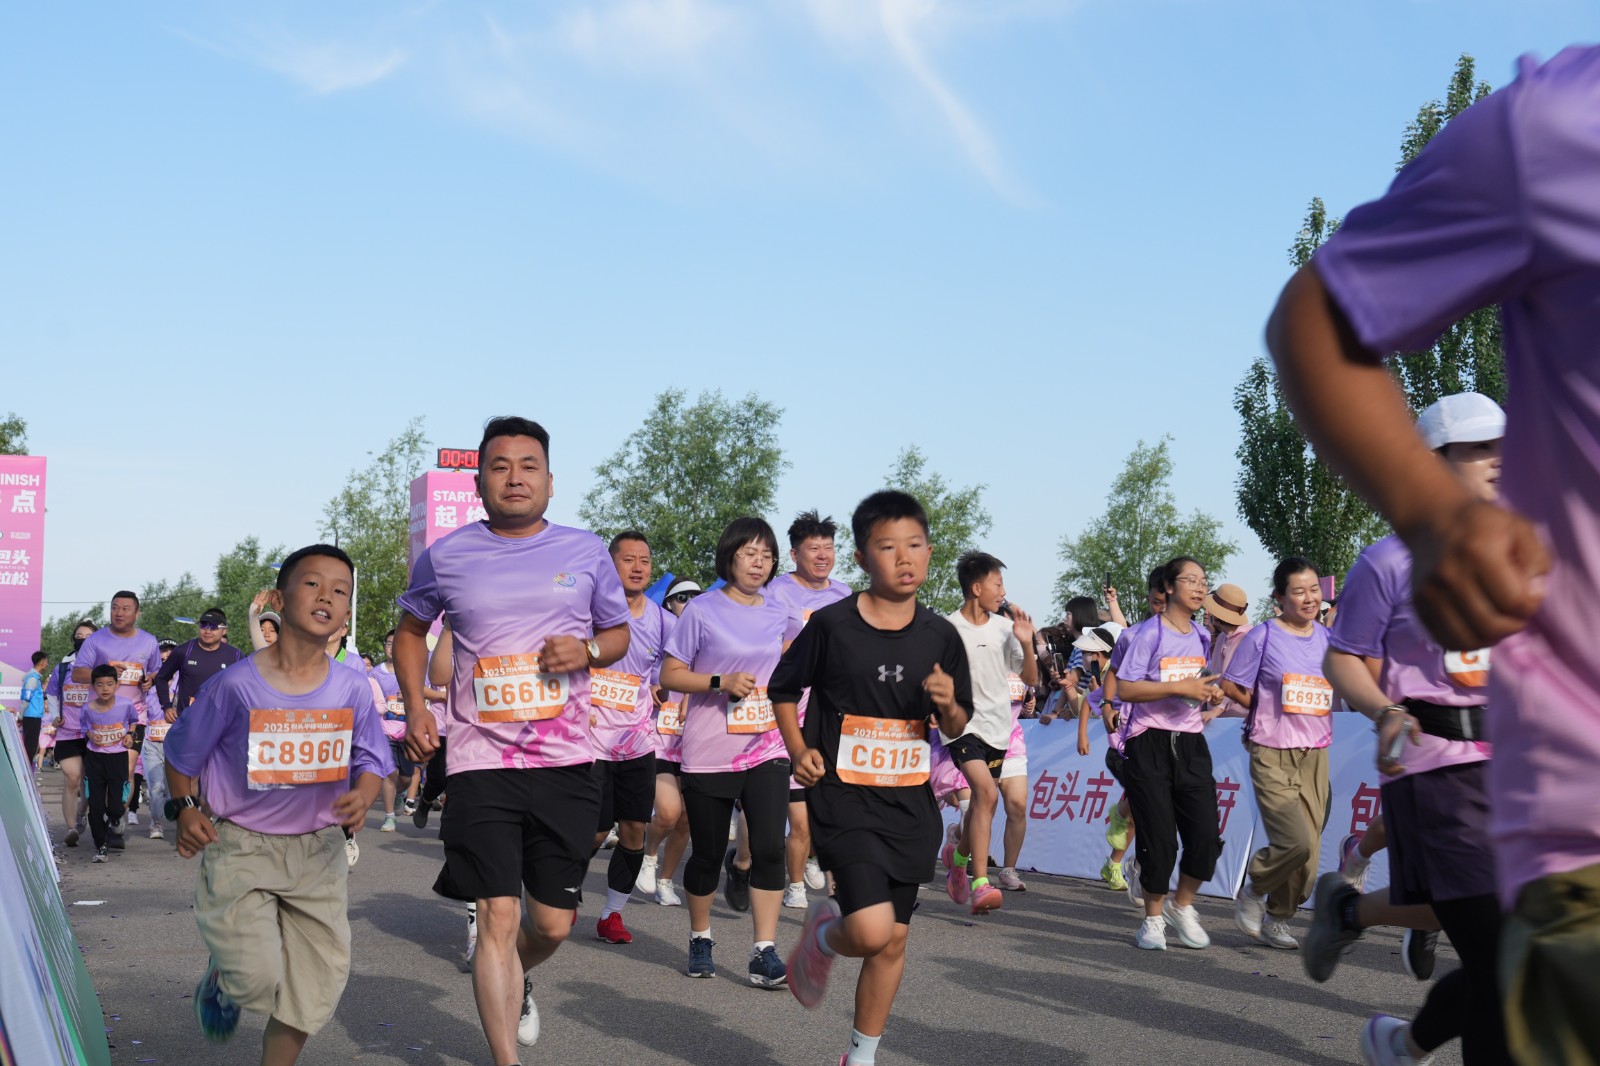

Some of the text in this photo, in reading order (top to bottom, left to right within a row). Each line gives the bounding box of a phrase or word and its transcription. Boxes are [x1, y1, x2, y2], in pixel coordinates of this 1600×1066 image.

[483, 667, 506, 678] 2025
[484, 678, 562, 707] C6619
[590, 682, 635, 703] C8572
[1285, 689, 1331, 707] C6935
[263, 722, 290, 733] 2025
[853, 727, 878, 739] 2025
[257, 738, 345, 766] C8960
[851, 744, 922, 769] C6115
[1029, 769, 1125, 825] 包头市
